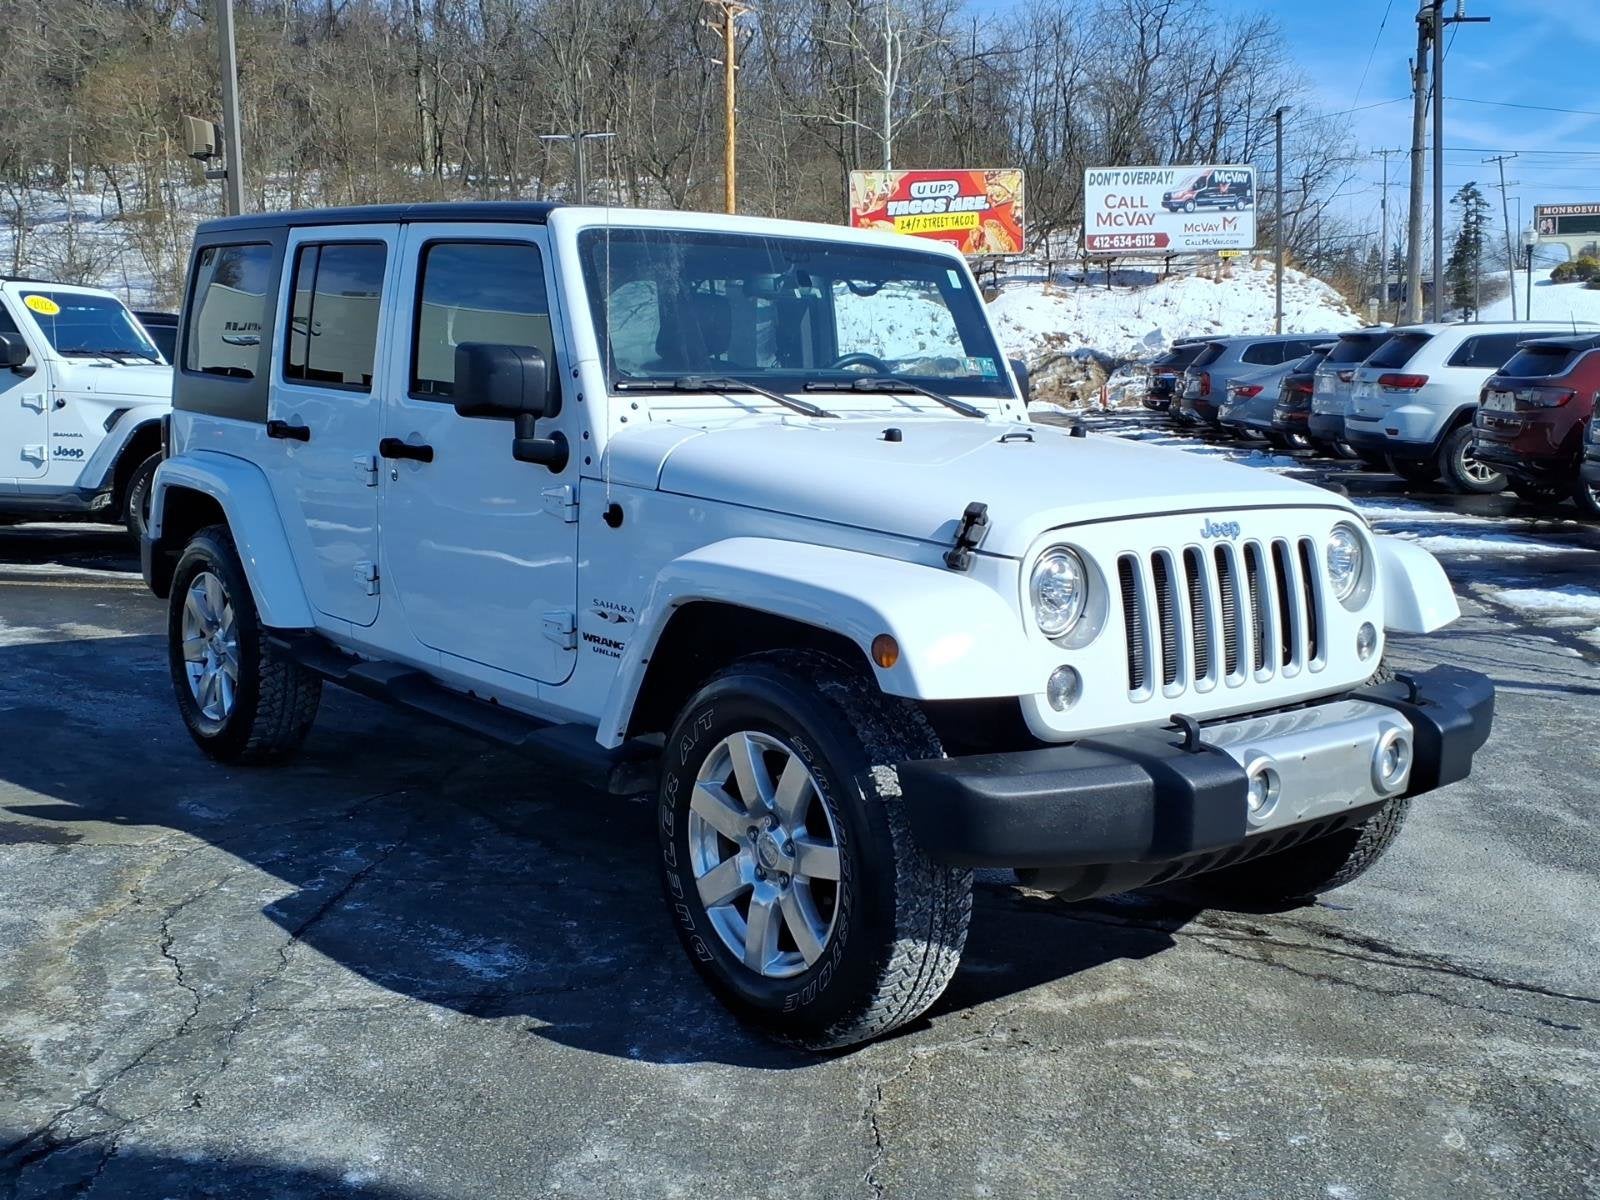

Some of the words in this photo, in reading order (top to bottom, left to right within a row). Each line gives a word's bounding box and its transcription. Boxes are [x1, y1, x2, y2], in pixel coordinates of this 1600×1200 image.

[1089, 171, 1121, 186] DON'T
[1122, 171, 1174, 185] OVERPAY!
[917, 185, 926, 195] U
[929, 184, 954, 194] UP?
[887, 199, 948, 216] TACOS
[948, 196, 991, 213] ARE.
[1104, 194, 1149, 209] CALL
[1543, 205, 1600, 214] MONROEVI
[900, 218, 921, 230] 24/7
[922, 216, 949, 229] STREET
[950, 214, 975, 226] TACOS
[1093, 235, 1156, 248] 412-634-6112
[53, 445, 84, 459] Jeep
[1200, 518, 1241, 541] Jeep
[593, 598, 636, 615] SAHARA
